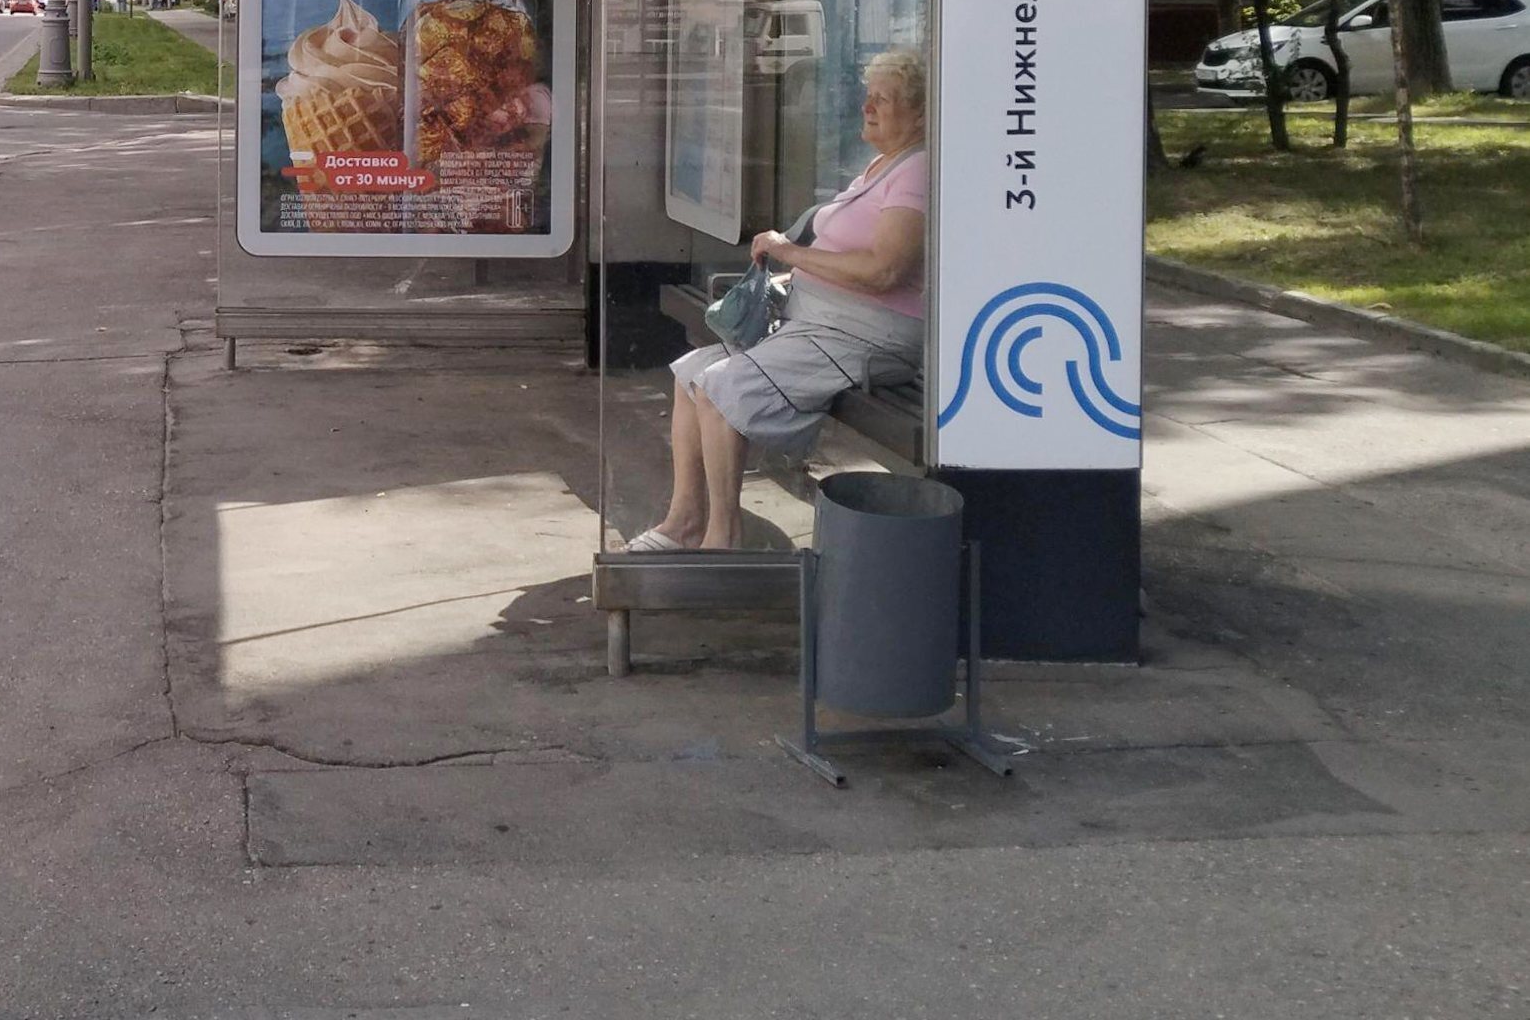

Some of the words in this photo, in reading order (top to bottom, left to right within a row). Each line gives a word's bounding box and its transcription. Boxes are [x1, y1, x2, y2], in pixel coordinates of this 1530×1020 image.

[325, 155, 399, 168] Доставка
[335, 176, 352, 186] от
[356, 174, 373, 186] 30
[377, 175, 426, 188] минут
[1006, 150, 1036, 210] 3-й
